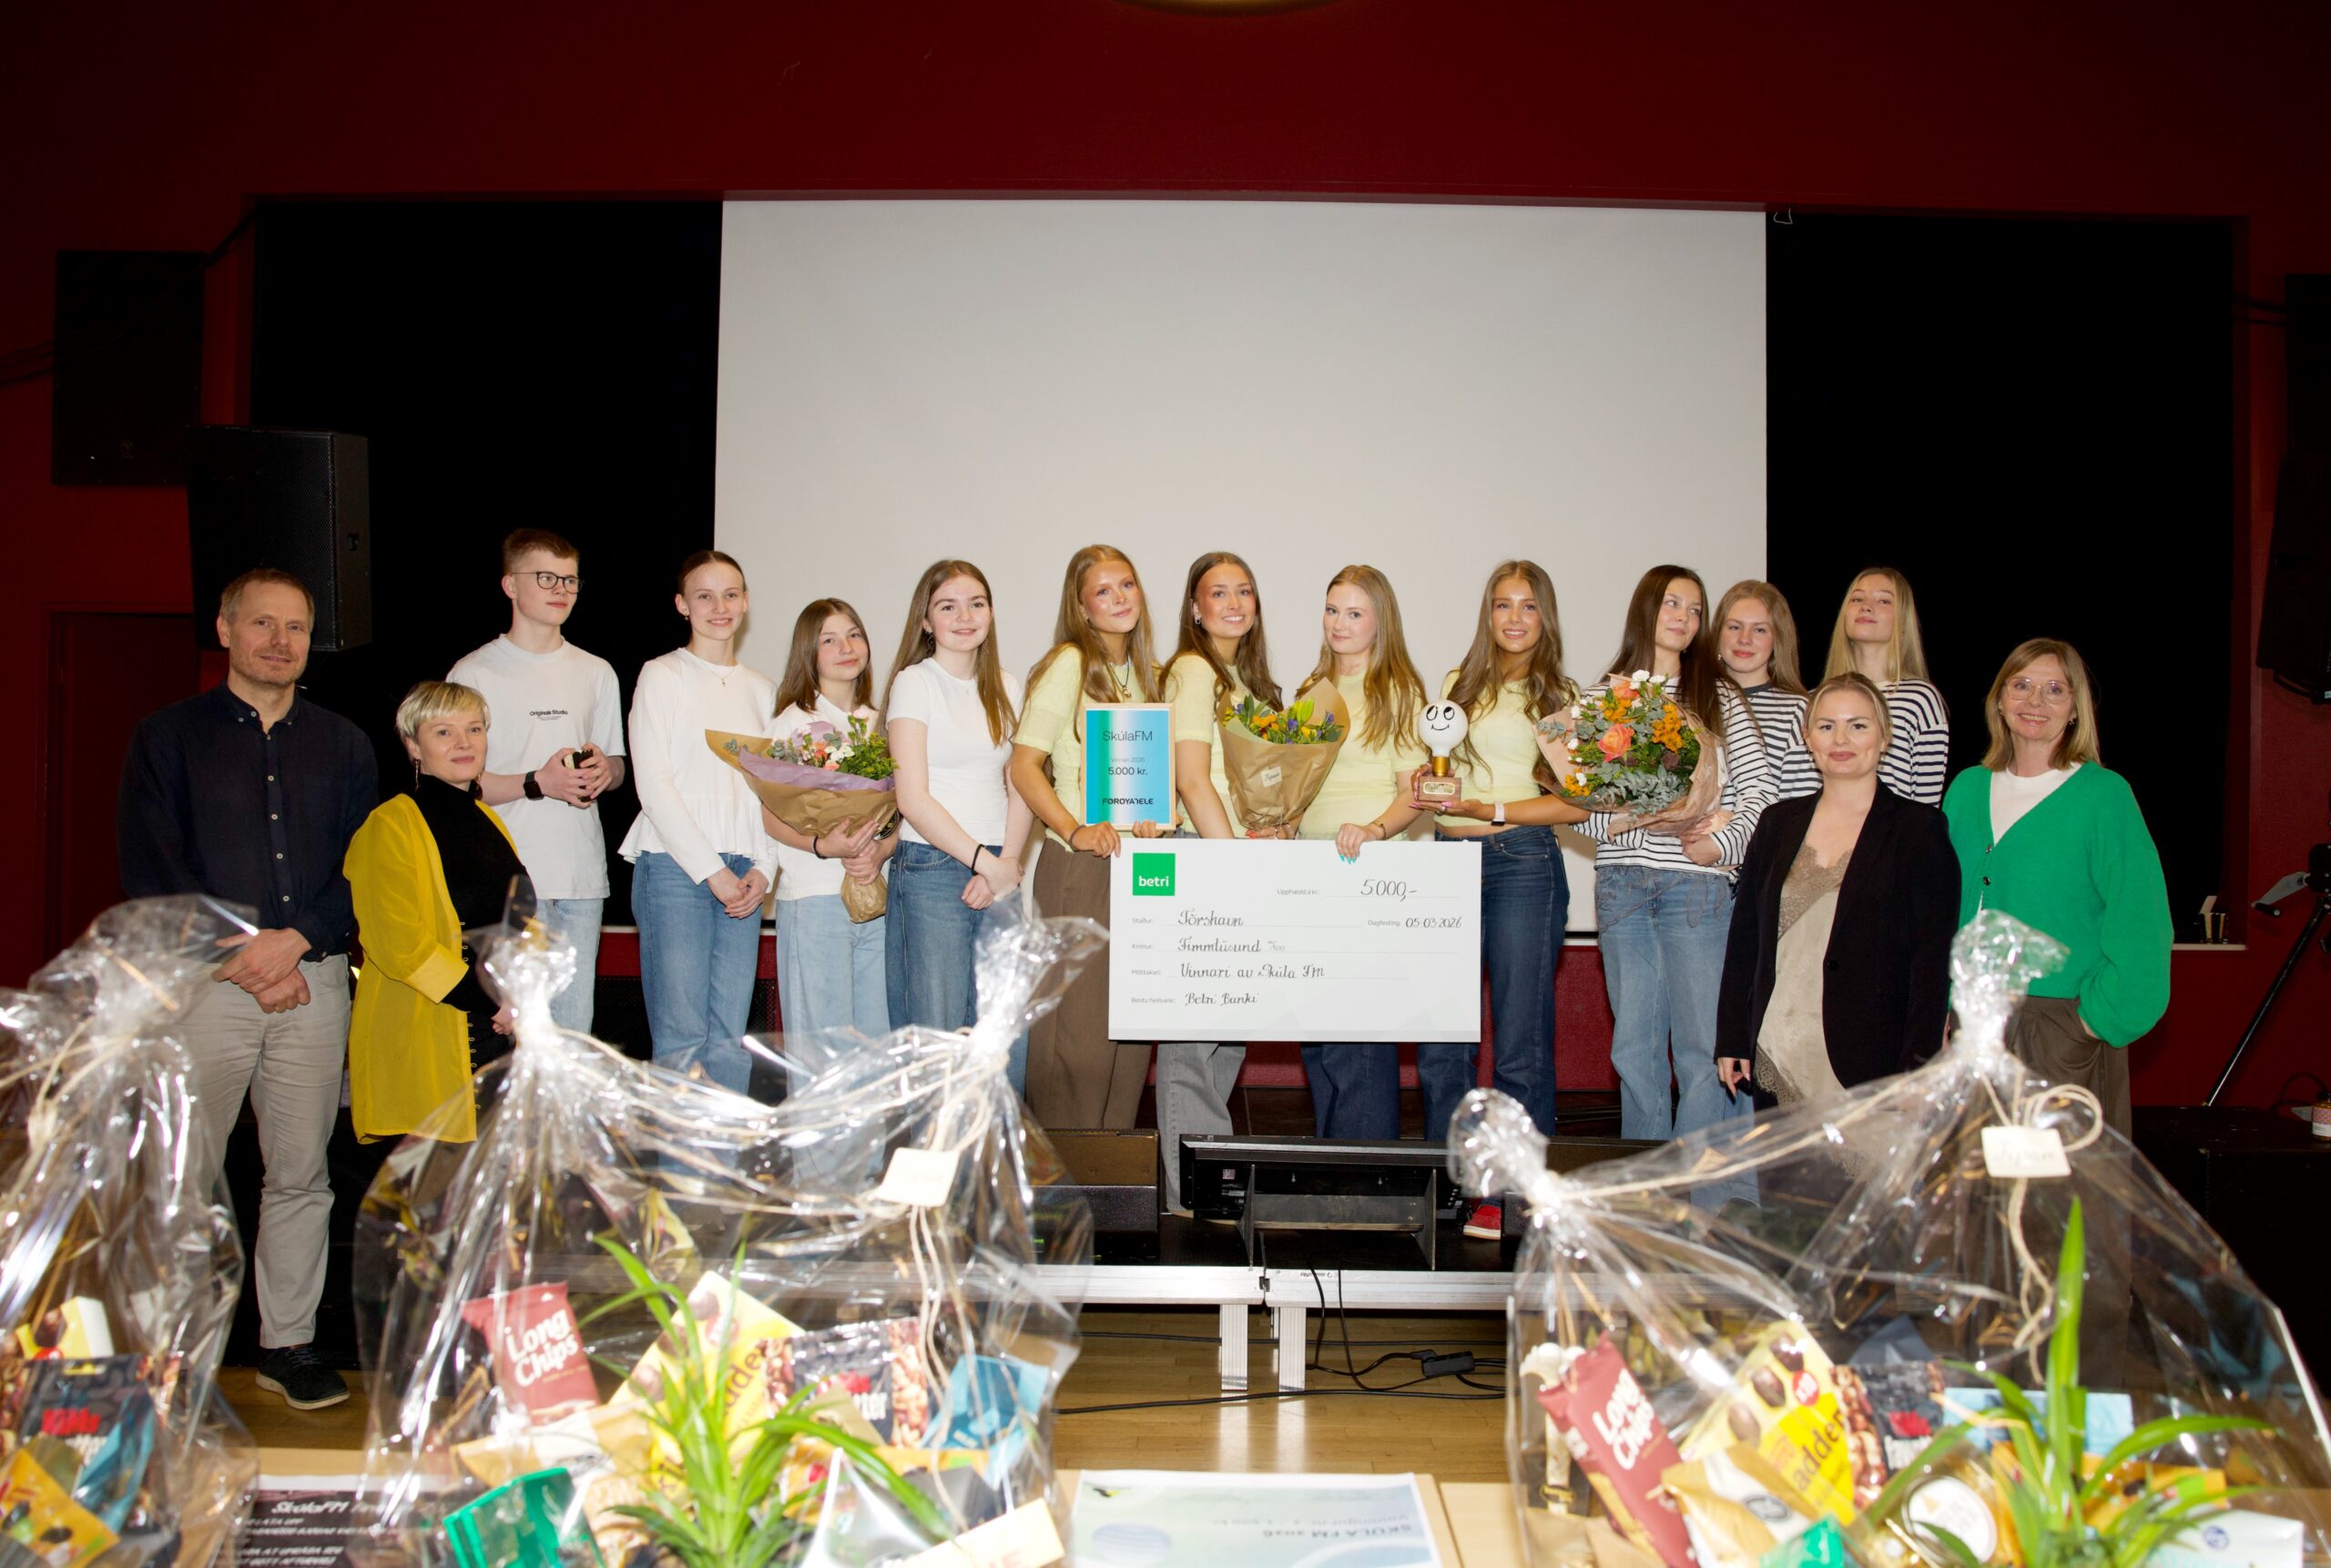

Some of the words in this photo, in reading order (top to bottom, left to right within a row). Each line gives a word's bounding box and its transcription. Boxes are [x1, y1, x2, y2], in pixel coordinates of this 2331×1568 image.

[1103, 730, 1153, 742] SkúlaFM
[1136, 767, 1148, 776] kr.
[1138, 875, 1169, 887] betri
[1180, 962, 1230, 978] Vinnari
[1237, 967, 1254, 979] av
[1185, 992, 1216, 1006] Betri
[1220, 992, 1259, 1006] Banki
[504, 1308, 571, 1362] Long
[514, 1333, 578, 1387] Chips
